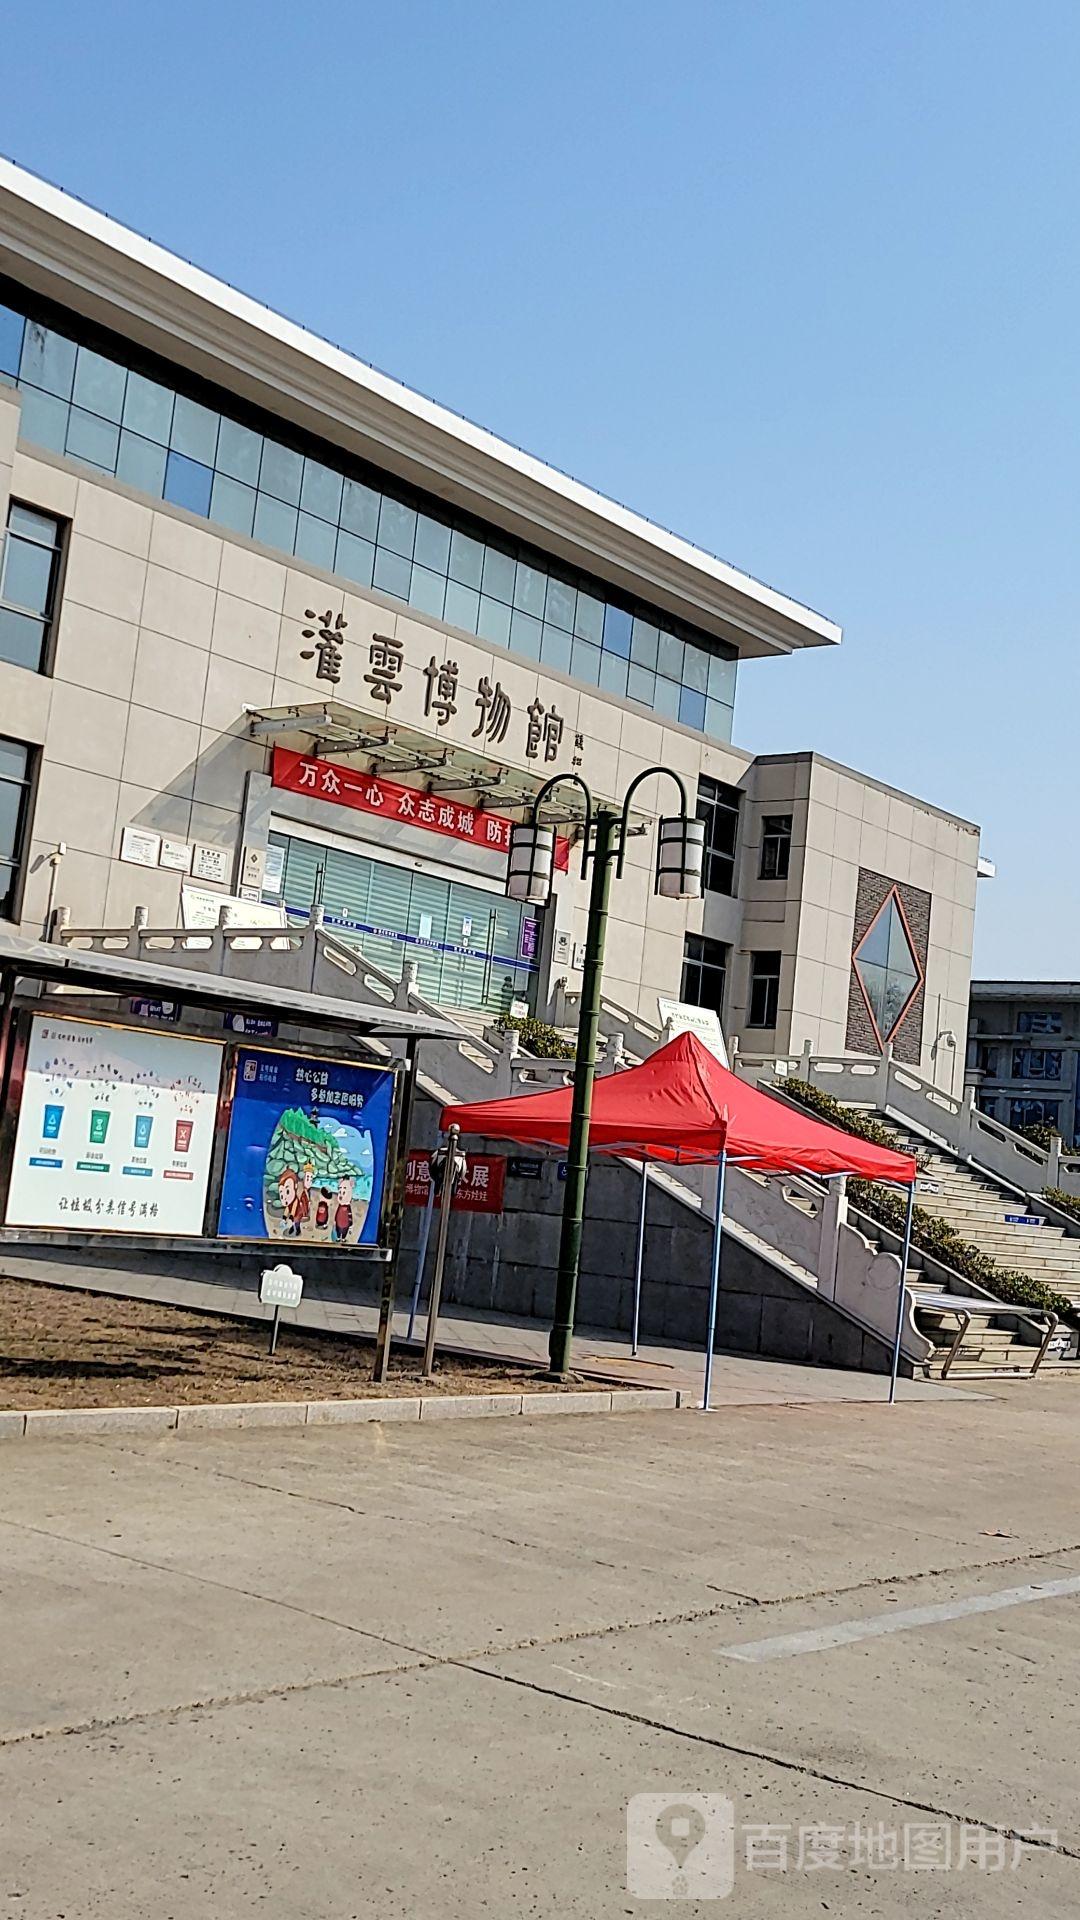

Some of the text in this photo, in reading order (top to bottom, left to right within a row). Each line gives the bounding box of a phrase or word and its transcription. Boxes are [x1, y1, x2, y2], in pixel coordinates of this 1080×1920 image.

[297, 760, 385, 807] 万众一心
[397, 791, 475, 836] 众志成城
[58, 1196, 159, 1218] 让垃圾分类信号满格
